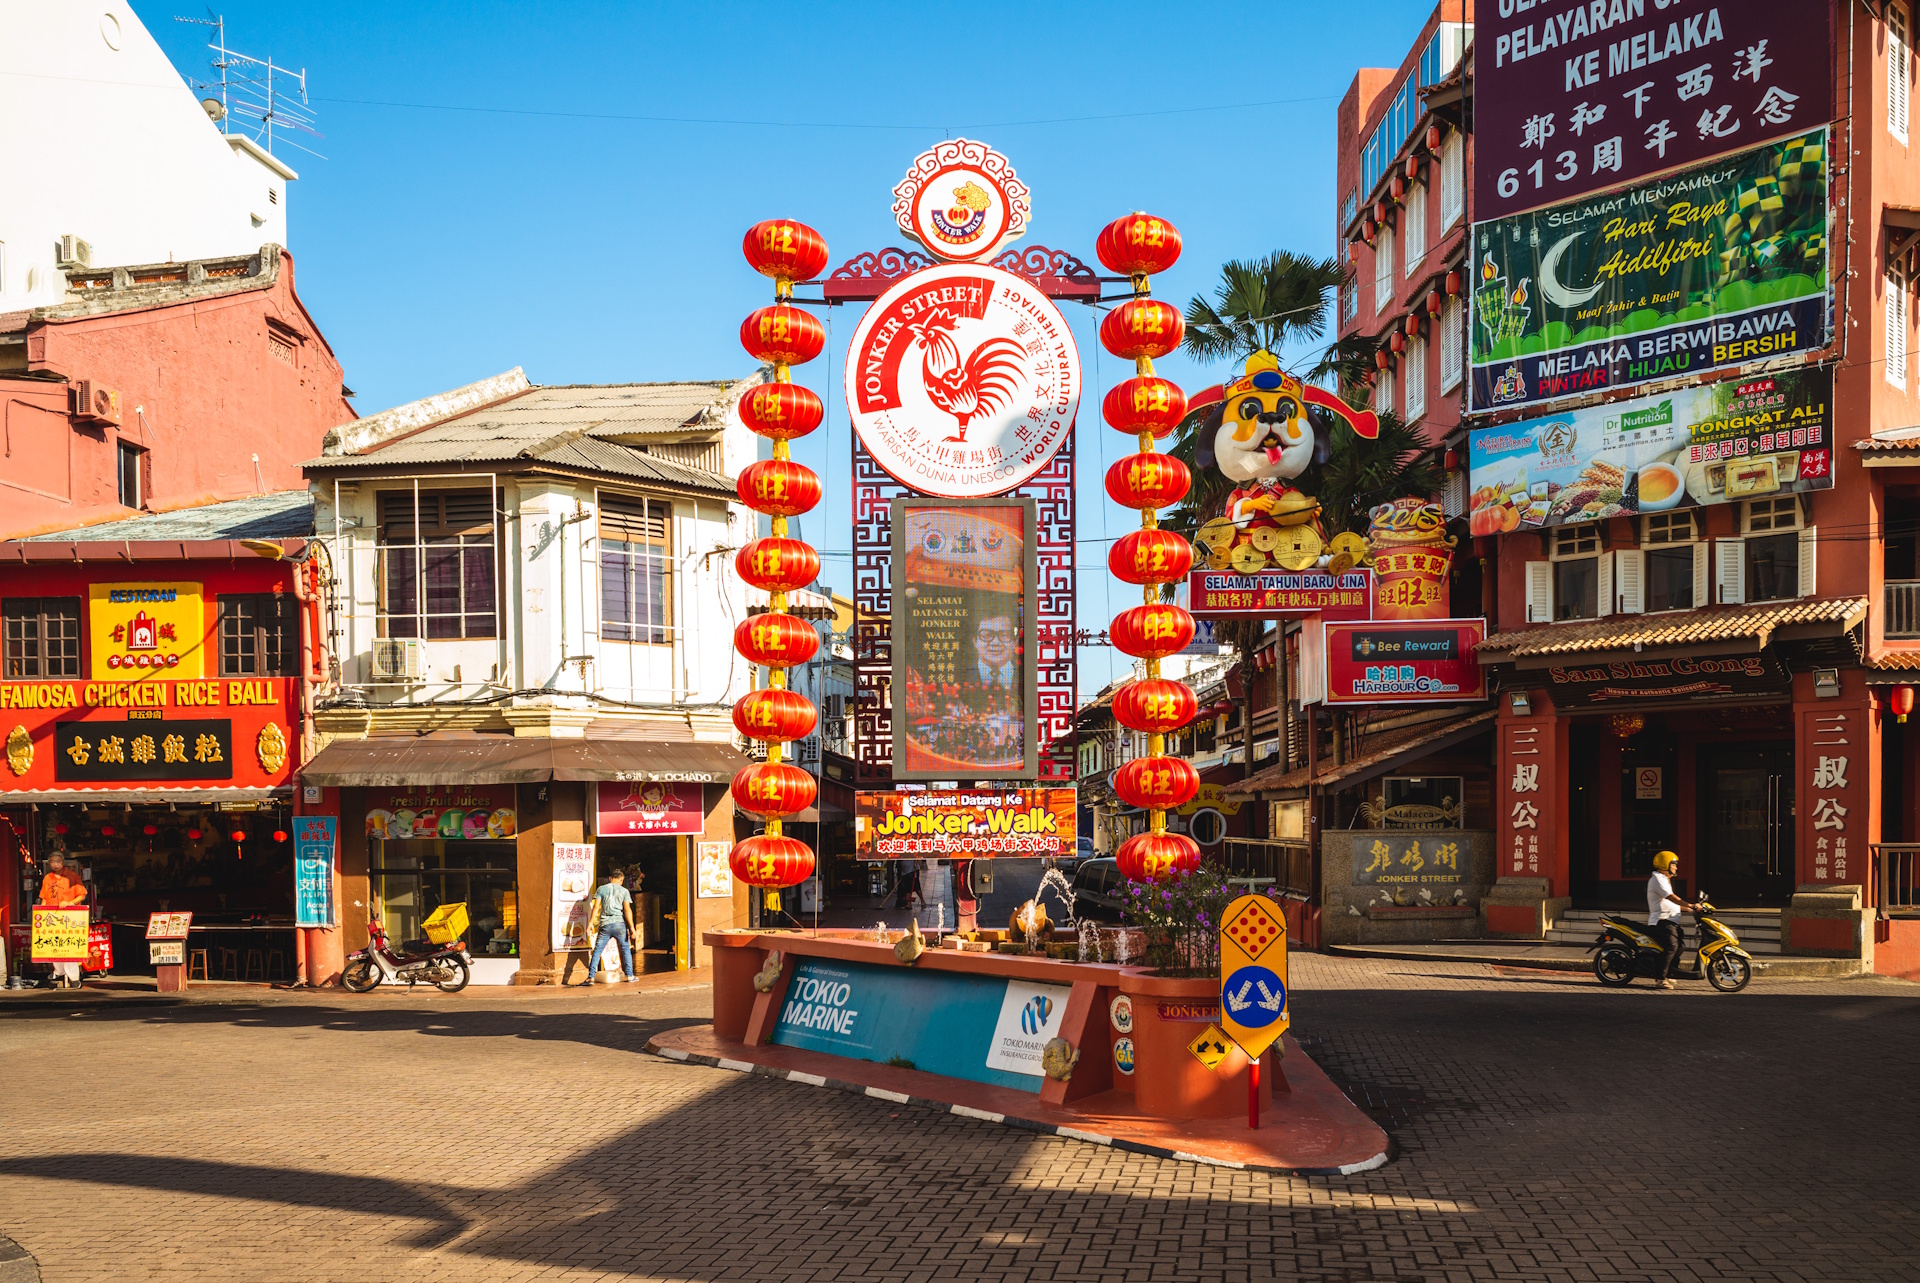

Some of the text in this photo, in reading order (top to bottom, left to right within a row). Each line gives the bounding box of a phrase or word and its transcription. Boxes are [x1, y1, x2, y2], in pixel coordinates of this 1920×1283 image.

[1496, 0, 1645, 68] PELAYARAN
[1565, 8, 1724, 92] KE MELAKA
[1519, 39, 1774, 150] 鄭和下西洋
[1547, 168, 1737, 228] SELAMAT MENYAMBUT
[934, 214, 983, 236] JONKER WALK
[1132, 220, 1164, 247] 旺
[1603, 198, 1729, 245] Hari Raya
[763, 226, 797, 254] 旺
[1593, 232, 1714, 285] Aidilfitri
[1576, 289, 1681, 321] Maaf Zahir & Batin
[759, 316, 793, 343] 旺
[1131, 305, 1164, 334] 旺
[866, 285, 982, 405] JONKER STREET
[1538, 310, 1796, 378] MELAKA BERWIBAWA
[1538, 331, 1796, 396] PINTAR HIJAU BERSIH
[1003, 287, 1071, 468] WORLD CULTURAL HERITAGE
[753, 393, 786, 422] 旺
[1134, 385, 1169, 412] 旺
[1606, 413, 1667, 430] Dr Nutrition
[1687, 409, 1785, 436] TONGKAT
[1790, 403, 1824, 420] ALI
[873, 417, 1015, 486] WARISAN DUNIA UNESCO
[755, 473, 789, 500] 旺
[1127, 464, 1164, 490] 旺
[1373, 503, 1441, 530] 2018
[751, 549, 785, 577] 旺
[1134, 544, 1168, 573] 旺
[1375, 553, 1446, 575] 恭喜发财
[1205, 574, 1367, 590] SELAMAT TAHUN BARU CINA
[110, 589, 177, 603] RESTORAN
[917, 596, 964, 605] SELAMAT
[912, 609, 969, 617] DATANG KE
[920, 619, 960, 628] JONKER
[1143, 612, 1177, 640] 旺
[109, 623, 125, 643] 古
[751, 625, 786, 651] 旺
[926, 631, 955, 640] WALK
[1378, 639, 1450, 652] Bee Reward
[928, 652, 955, 660] 马六甲
[1549, 656, 1765, 683] San Shu Gong
[1366, 665, 1416, 682] 哈泊购
[0, 681, 278, 709] FAMOSA CHICKEN RICE BALL
[1608, 687, 1629, 695] House
[1639, 687, 1671, 695] Authentic
[1672, 682, 1707, 693] Delicacies
[744, 700, 777, 728] 旺
[1145, 695, 1178, 720] 旺
[66, 733, 224, 766] 古城雞飯粒
[665, 773, 712, 782] OCHADO
[1139, 769, 1173, 795] 旺
[1511, 727, 1540, 830] 三叔公
[1812, 714, 1849, 830] 三叔公
[390, 795, 491, 807] Fresh Fruit Juices
[748, 775, 782, 801] 旺
[909, 795, 1023, 807] Selamat Datang Ke
[637, 804, 669, 812] MADAM
[877, 807, 1057, 836] Jonker Walk
[1394, 810, 1434, 818] Malacca
[306, 820, 326, 831] 古城
[877, 838, 1060, 854] 欢迎来到马六甲鸡场街文化坊
[1528, 835, 1538, 873] 有限公司
[1816, 837, 1828, 880] 食品廠
[1834, 837, 1848, 880] 有限公司
[746, 855, 780, 880] 旺
[1143, 854, 1176, 879] 旺
[1376, 875, 1461, 883] JONKER STREET
[299, 878, 332, 891] 支付宝
[813, 967, 828, 975] General
[828, 969, 849, 978] Insurance
[794, 976, 851, 1007] TOKIO
[782, 1000, 858, 1035] MARINE
[1164, 1006, 1220, 1018] JONKER
[1000, 1050, 1028, 1060] INSURANCE
[1003, 1038, 1045, 1052] TOKIO MARIN
